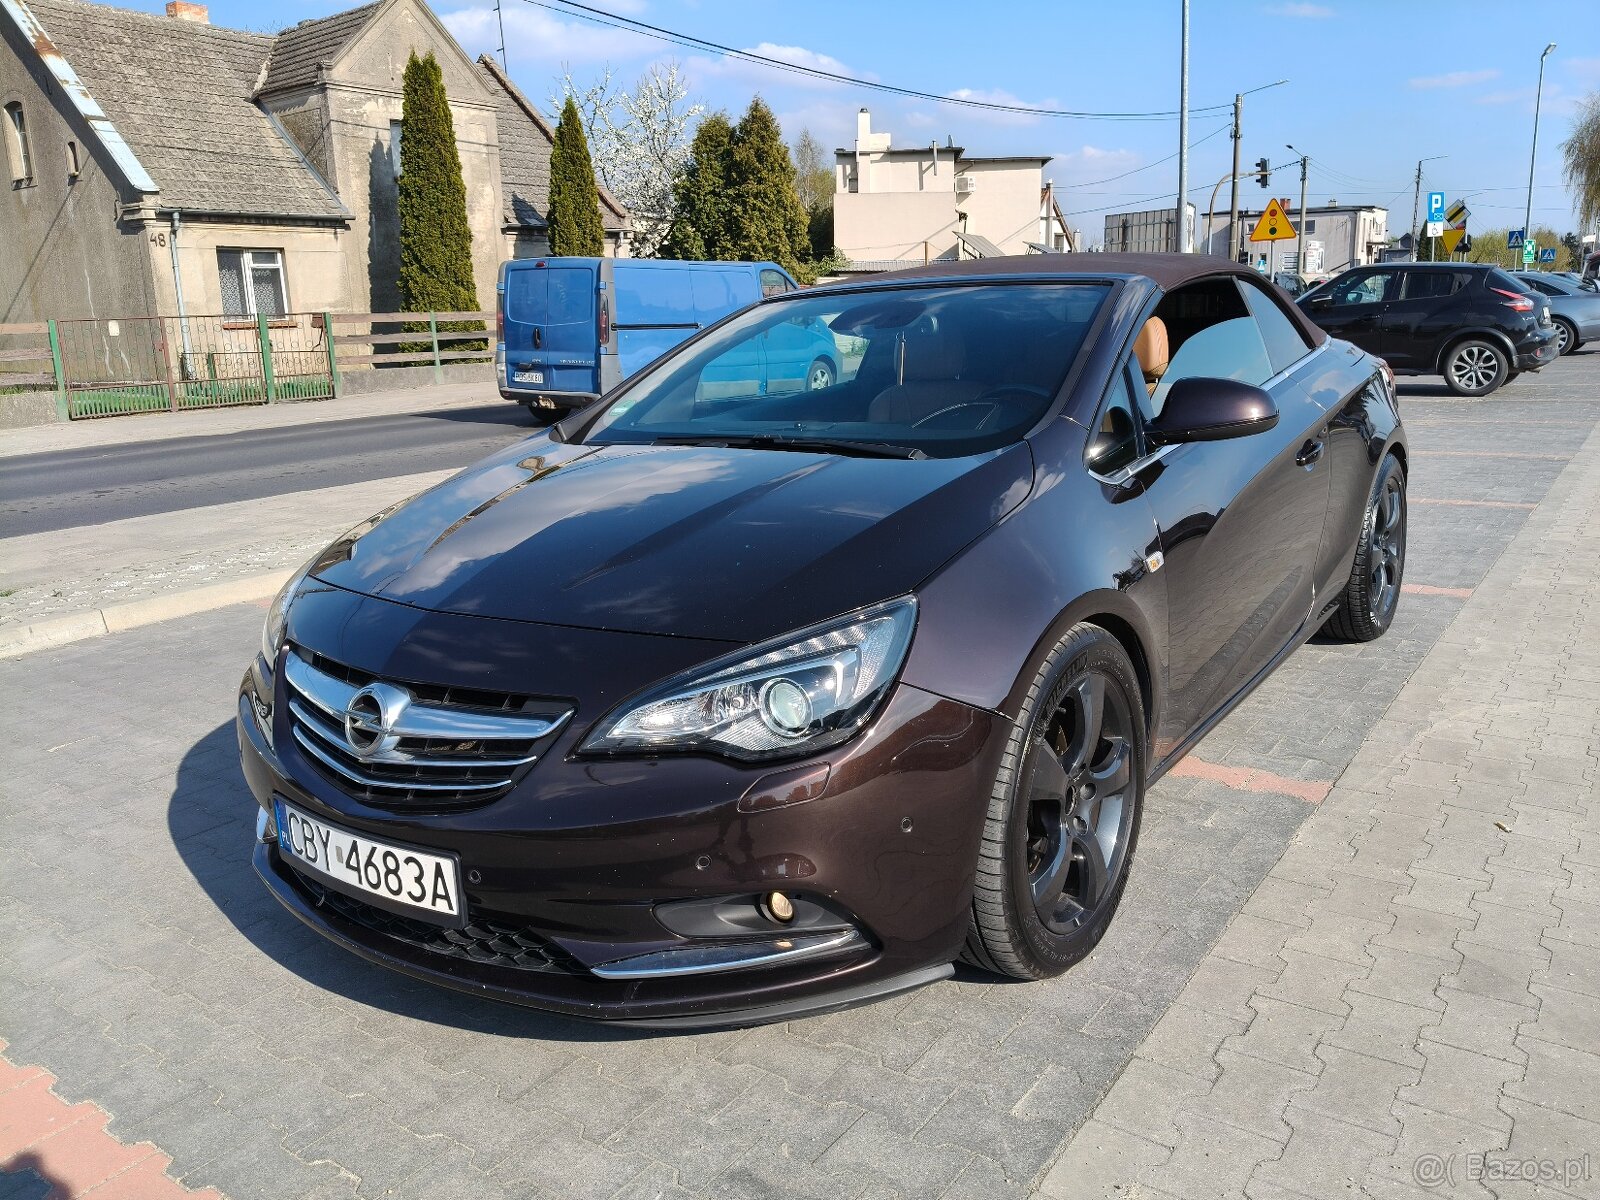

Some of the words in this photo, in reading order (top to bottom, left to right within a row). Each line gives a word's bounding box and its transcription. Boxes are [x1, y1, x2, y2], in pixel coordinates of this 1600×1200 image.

[1431, 194, 1442, 213] P
[150, 232, 166, 247] 48
[281, 830, 290, 845] PL
[288, 812, 331, 872] CBY
[345, 839, 454, 911] 4683A
